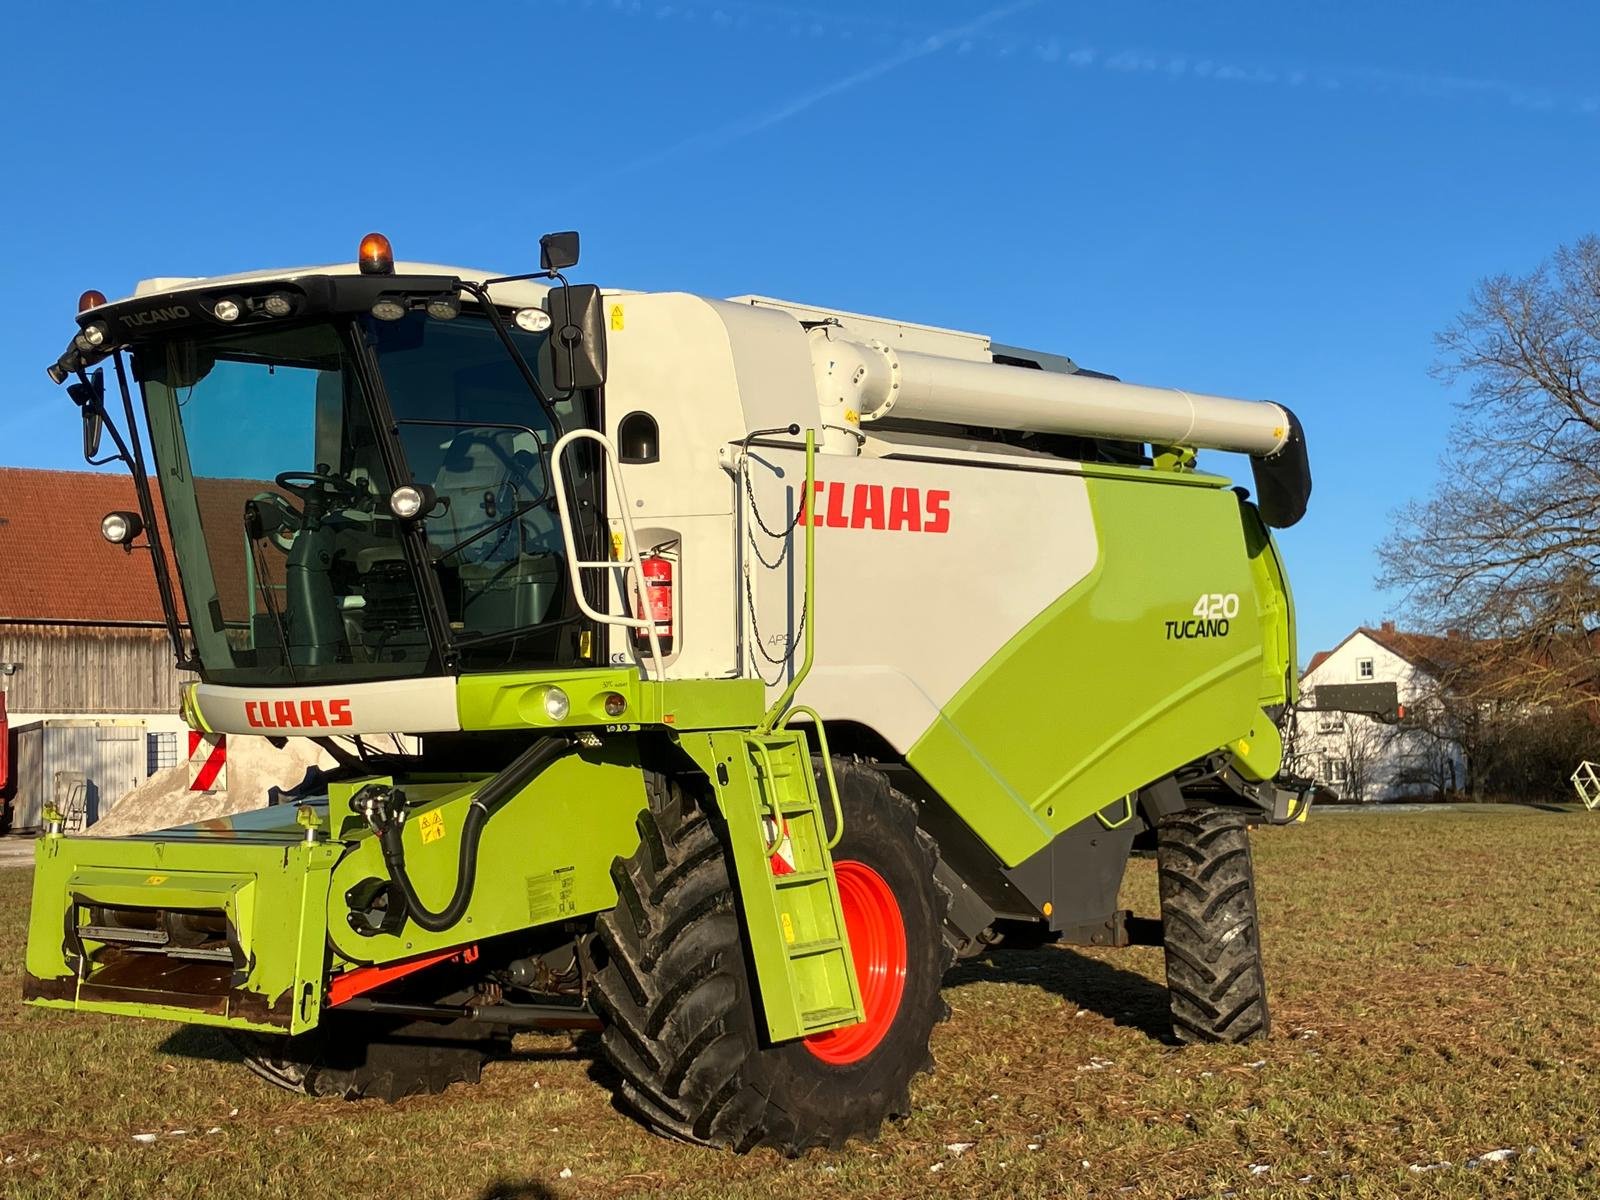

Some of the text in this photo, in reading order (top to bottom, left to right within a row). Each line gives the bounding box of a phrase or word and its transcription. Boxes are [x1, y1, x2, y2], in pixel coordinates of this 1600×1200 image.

[119, 305, 190, 328] TUCANO
[799, 480, 951, 533] CLAAS
[1192, 593, 1240, 619] 420
[1165, 619, 1229, 640] TUCANO
[245, 699, 353, 728] CLAAS
